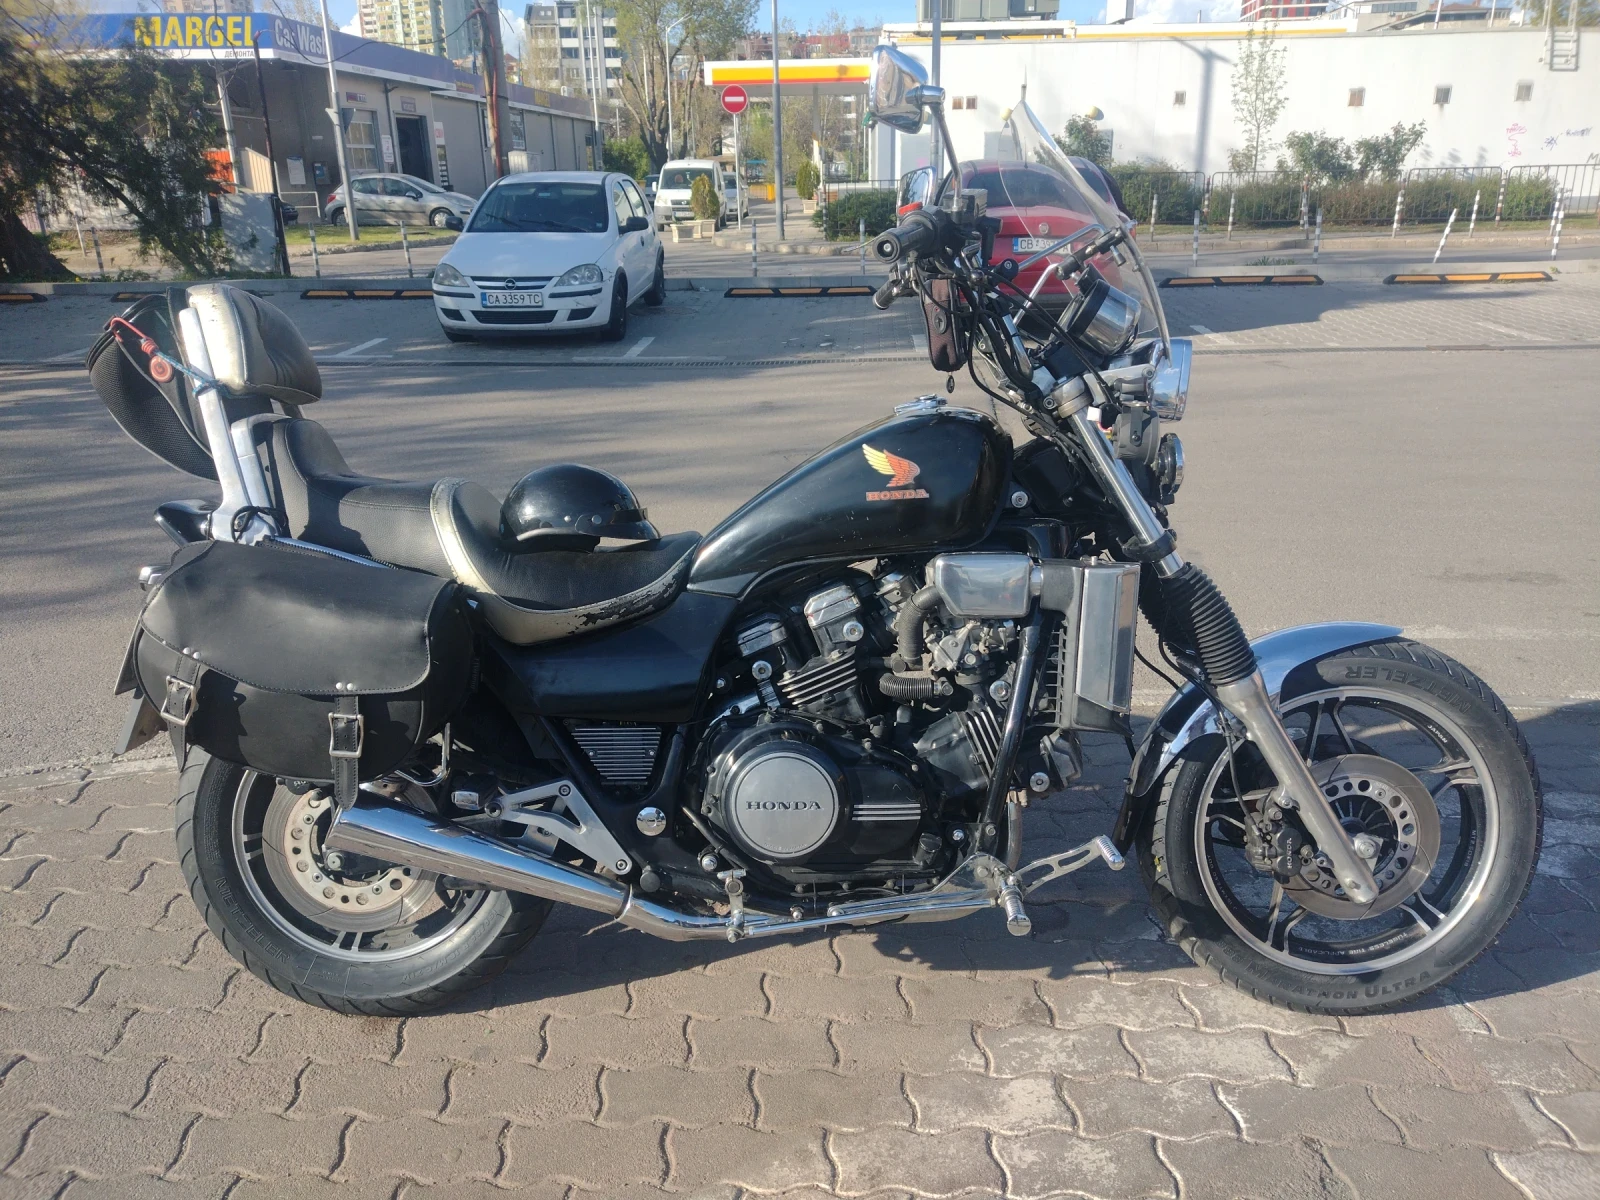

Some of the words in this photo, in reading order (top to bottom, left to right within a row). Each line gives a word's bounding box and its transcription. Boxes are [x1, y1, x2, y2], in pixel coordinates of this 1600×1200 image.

[134, 15, 255, 47] MARGEL
[224, 50, 258, 58] ДЕМОНТА
[488, 294, 501, 305] CA
[502, 294, 525, 305] 3359
[527, 294, 540, 304] TC
[866, 489, 929, 501] HONDA
[1344, 665, 1472, 714] METZELER
[1427, 724, 1448, 743] JAPAN
[745, 800, 824, 811] HONDA
[215, 876, 292, 963] METZELER
[1364, 970, 1432, 998] ULTRA
